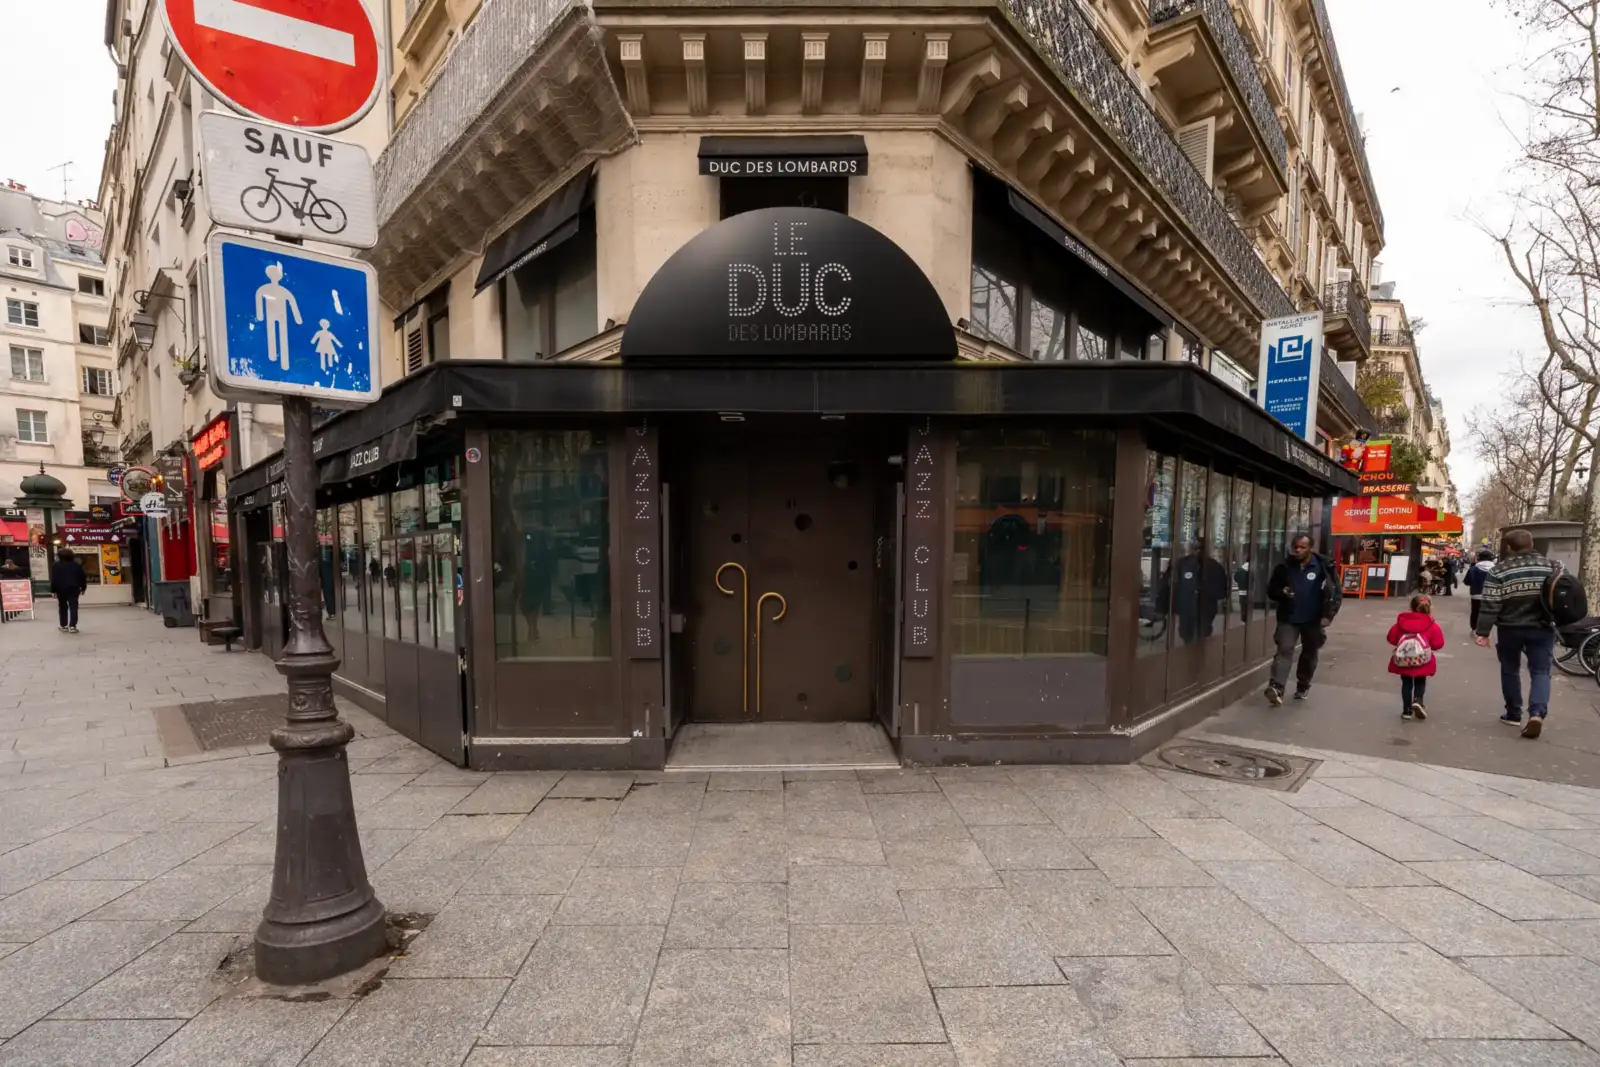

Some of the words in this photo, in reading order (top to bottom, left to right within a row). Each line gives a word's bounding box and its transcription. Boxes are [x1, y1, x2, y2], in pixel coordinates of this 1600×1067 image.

[244, 127, 334, 168] SAUF
[709, 160, 741, 173] DUC
[746, 160, 773, 173] DES
[778, 160, 858, 173] LOMBARDS
[773, 221, 808, 256] LE
[1064, 235, 1076, 251] DUC
[1076, 244, 1086, 259] DES
[728, 262, 852, 318] DUC
[728, 323, 760, 342] DES
[764, 323, 852, 342] LOMBARDS
[1266, 314, 1319, 327] INSTALLATEUR
[1268, 375, 1308, 385] HERACLES
[350, 451, 363, 469] JAZZ
[363, 446, 380, 464] CLUB
[631, 417, 652, 520] JAZZ
[914, 416, 933, 520] JAZZ
[1363, 484, 1412, 494] BRASSERIE
[1344, 508, 1375, 516] SERVICE
[1379, 507, 1413, 515] CONTINU
[634, 546, 653, 647] CLUB
[912, 545, 931, 646] CLUB
